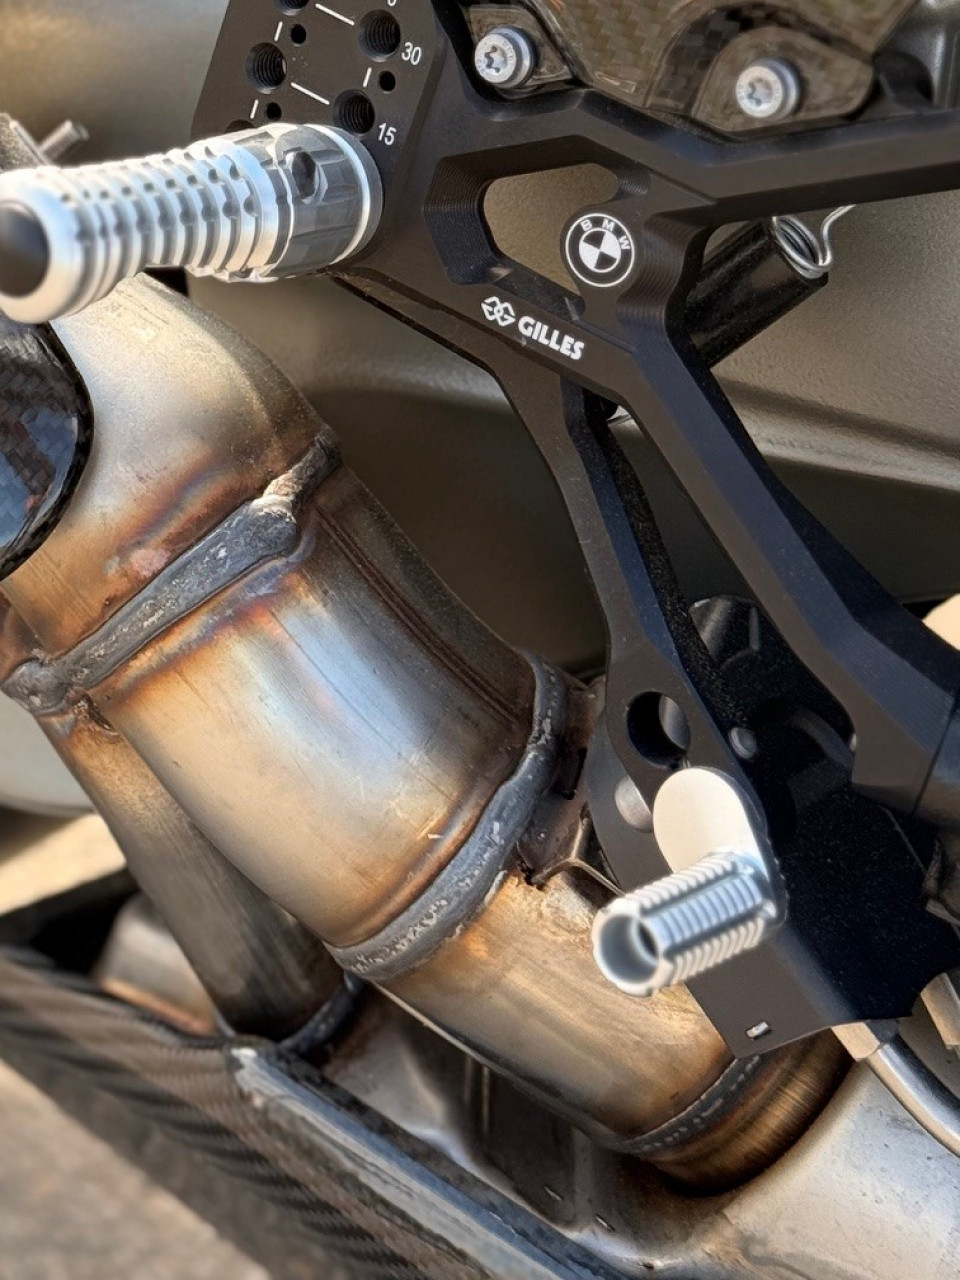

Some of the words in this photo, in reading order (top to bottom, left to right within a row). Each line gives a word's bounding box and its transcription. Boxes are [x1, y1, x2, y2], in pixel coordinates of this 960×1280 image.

[401, 41, 422, 66] 30
[378, 122, 396, 146] 15
[580, 218, 631, 251] BMW
[517, 315, 585, 360] GILLES
